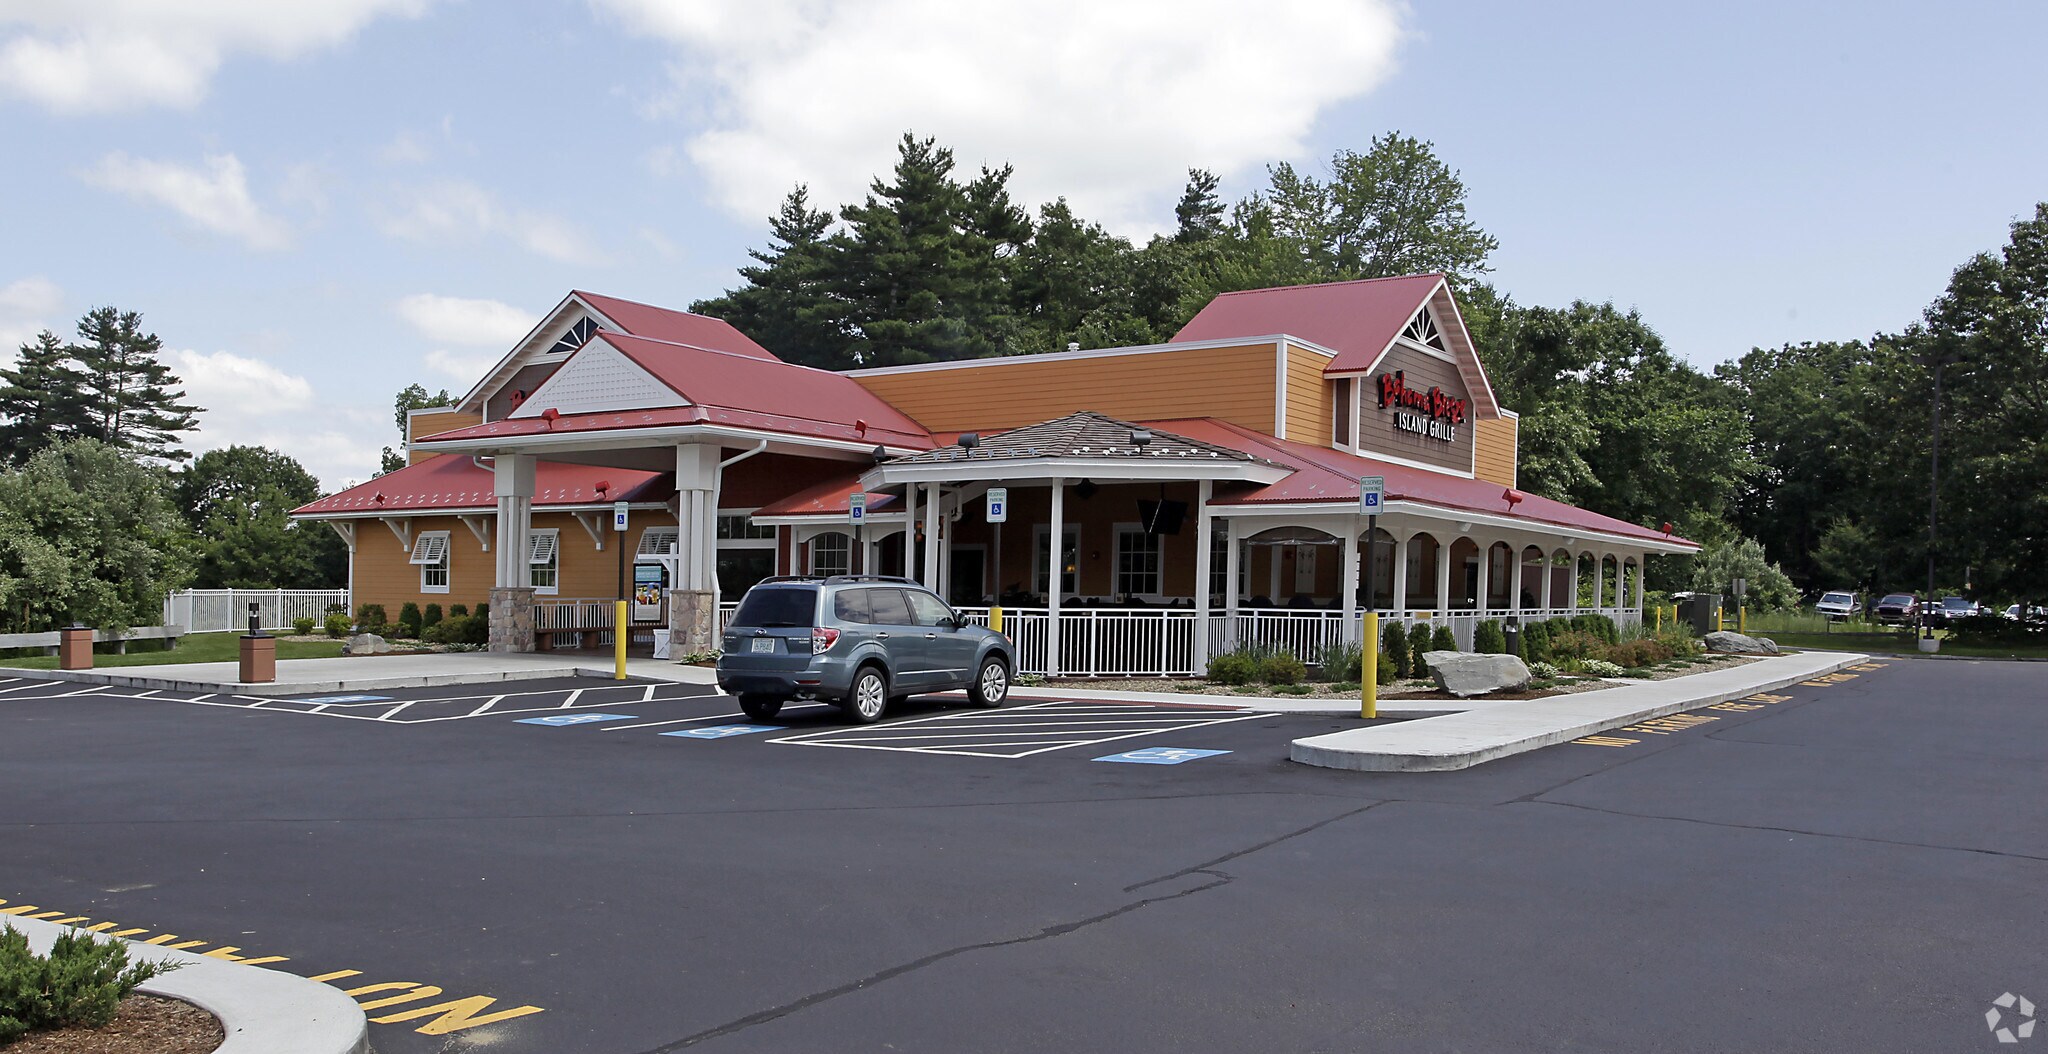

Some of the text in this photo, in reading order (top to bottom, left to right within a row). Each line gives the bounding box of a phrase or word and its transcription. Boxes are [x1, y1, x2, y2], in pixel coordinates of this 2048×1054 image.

[1379, 370, 1467, 424] Bahama Breeze
[1398, 412, 1455, 442] ISLAND GRILLE
